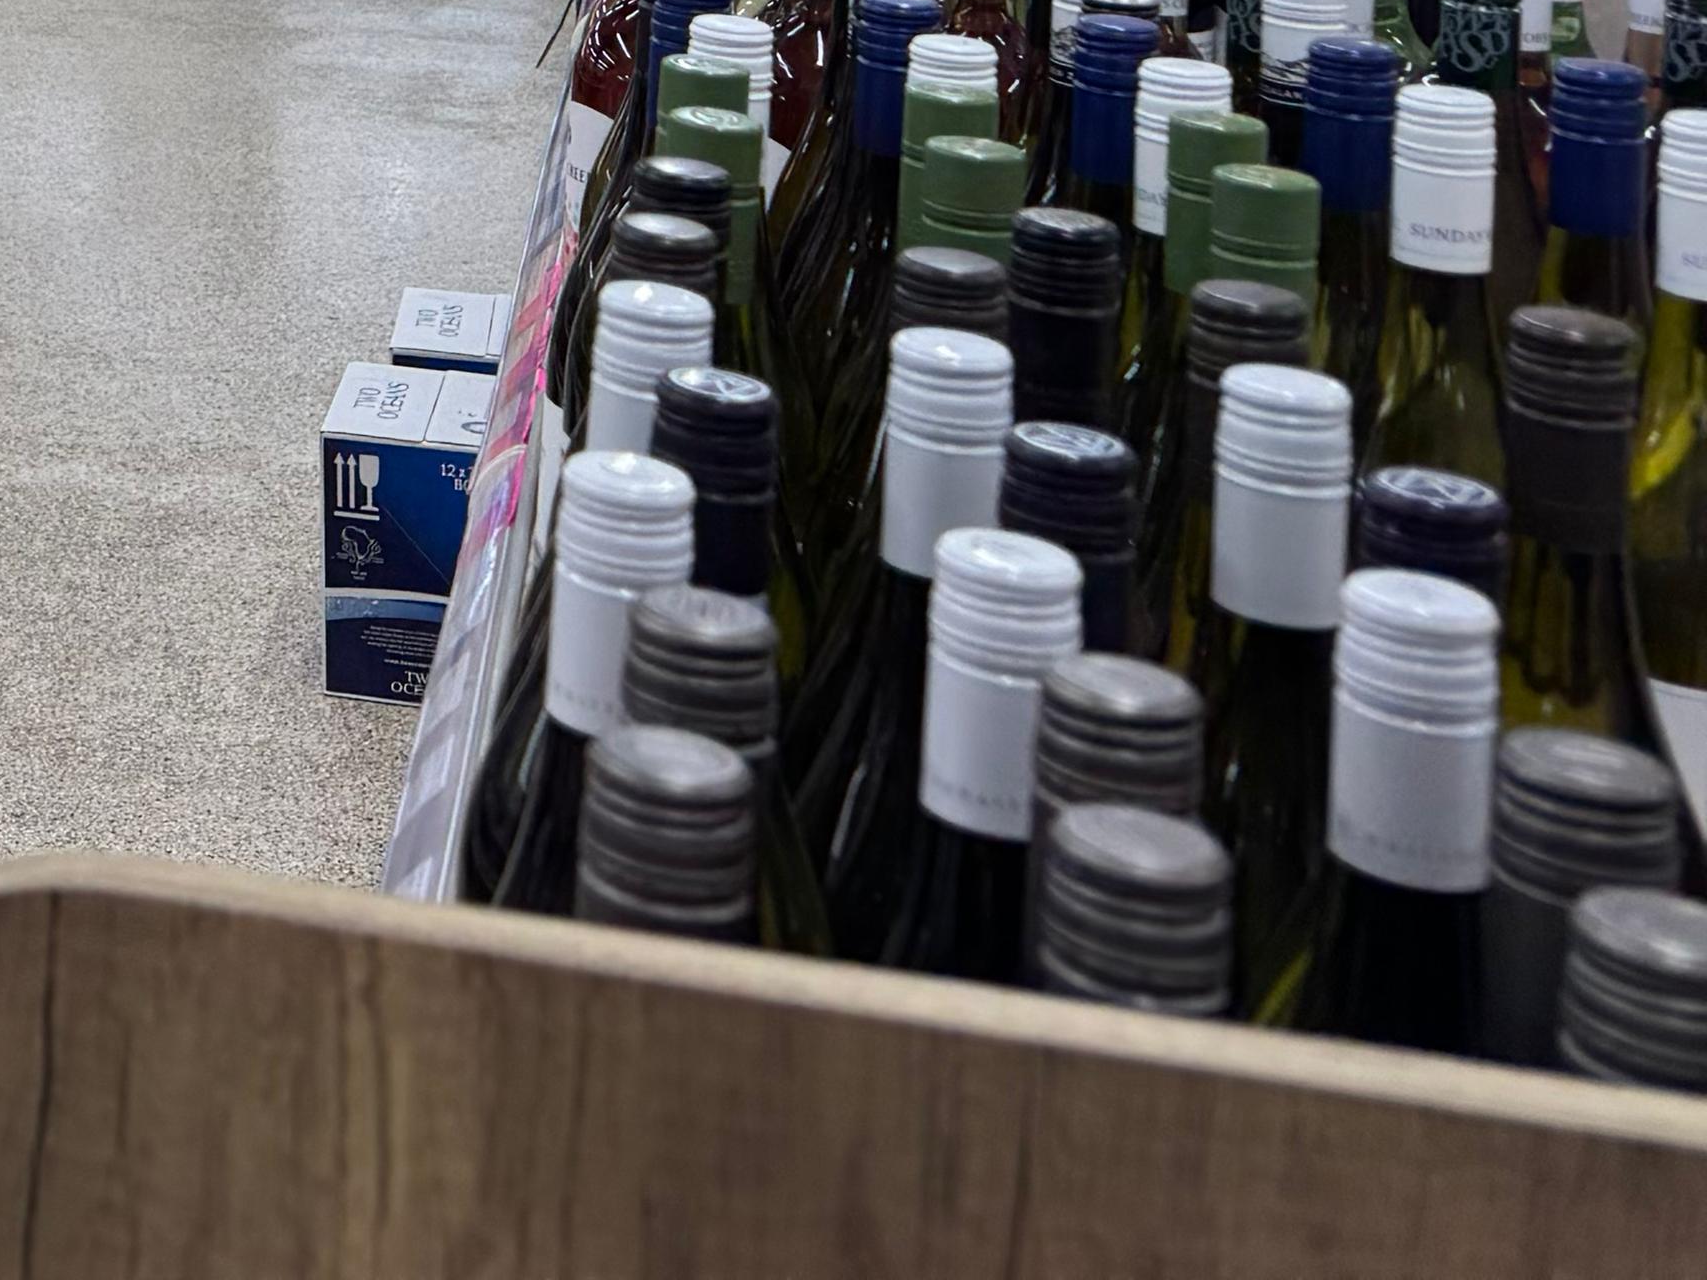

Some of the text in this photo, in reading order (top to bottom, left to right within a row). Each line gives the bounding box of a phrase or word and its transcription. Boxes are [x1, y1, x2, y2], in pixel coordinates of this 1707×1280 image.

[416, 309, 435, 328] TWO
[354, 387, 380, 409] TWO
[377, 382, 409, 420] OCEANS
[441, 464, 455, 477] 12
